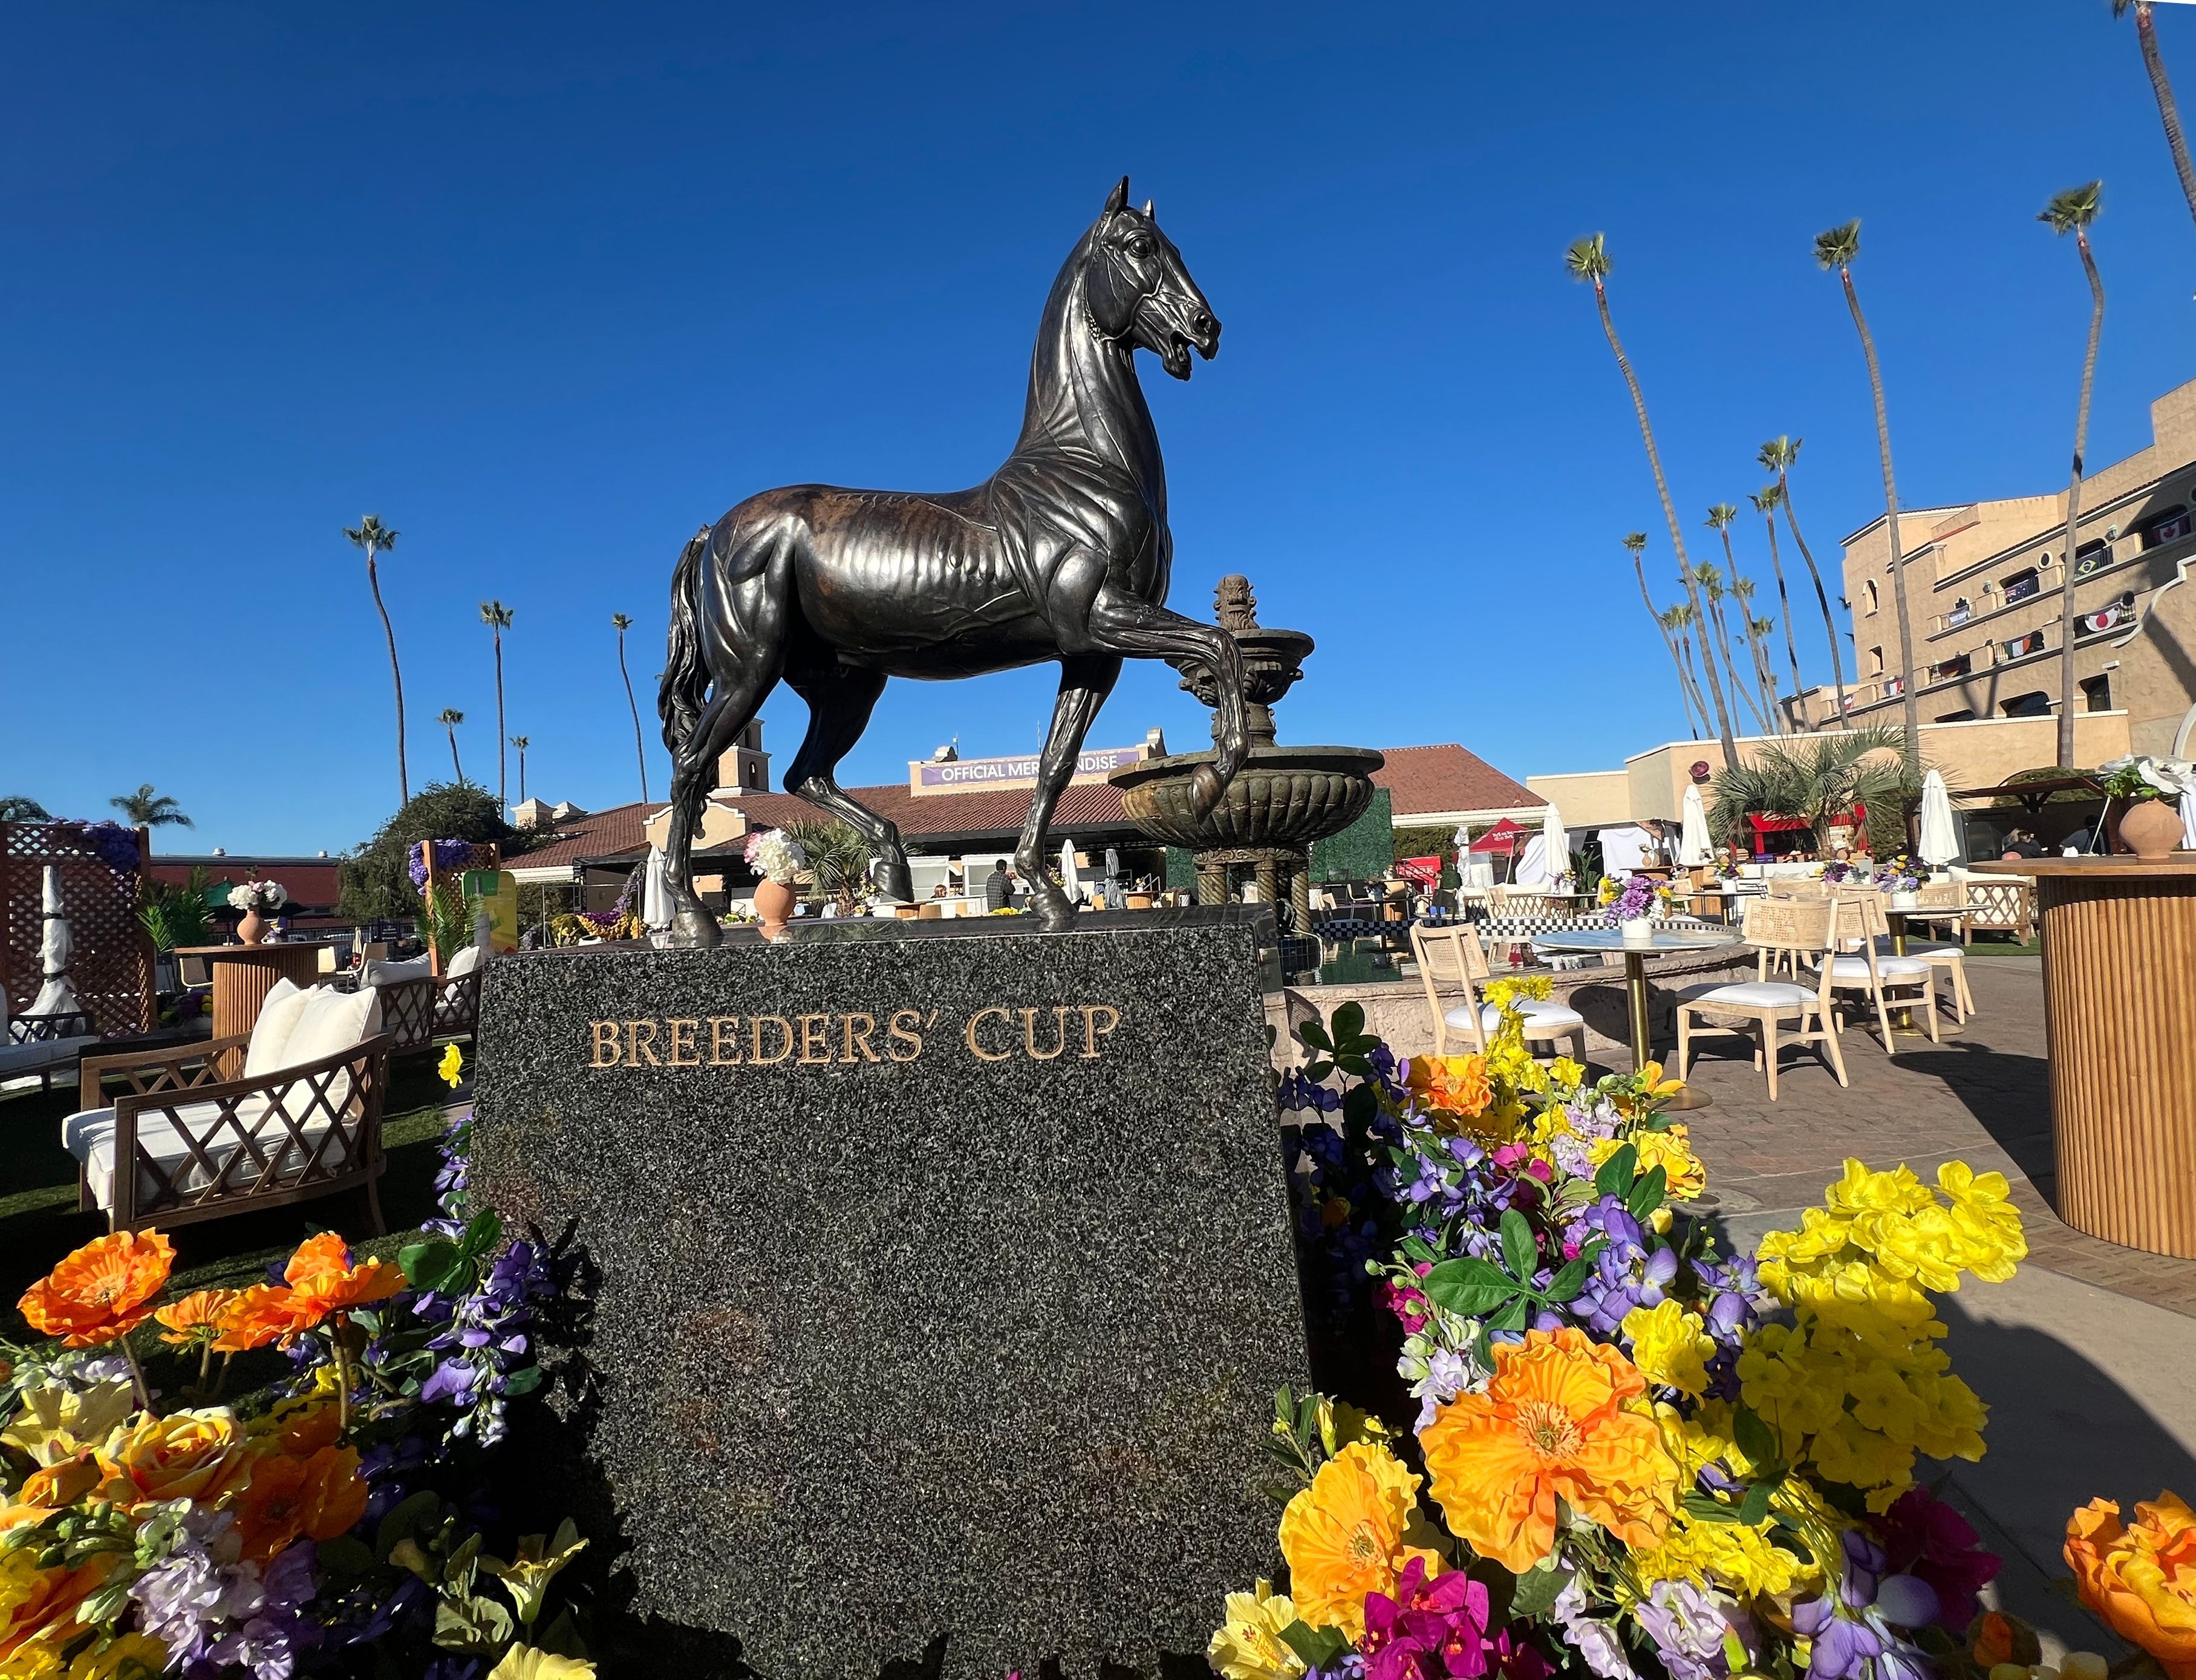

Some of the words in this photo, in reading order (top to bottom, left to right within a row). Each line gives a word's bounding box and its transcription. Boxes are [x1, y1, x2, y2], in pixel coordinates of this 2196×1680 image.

[941, 764, 1006, 781] OFFICIAL
[1009, 755, 1118, 777] MERNDISE
[967, 1004, 1120, 1061] CUP
